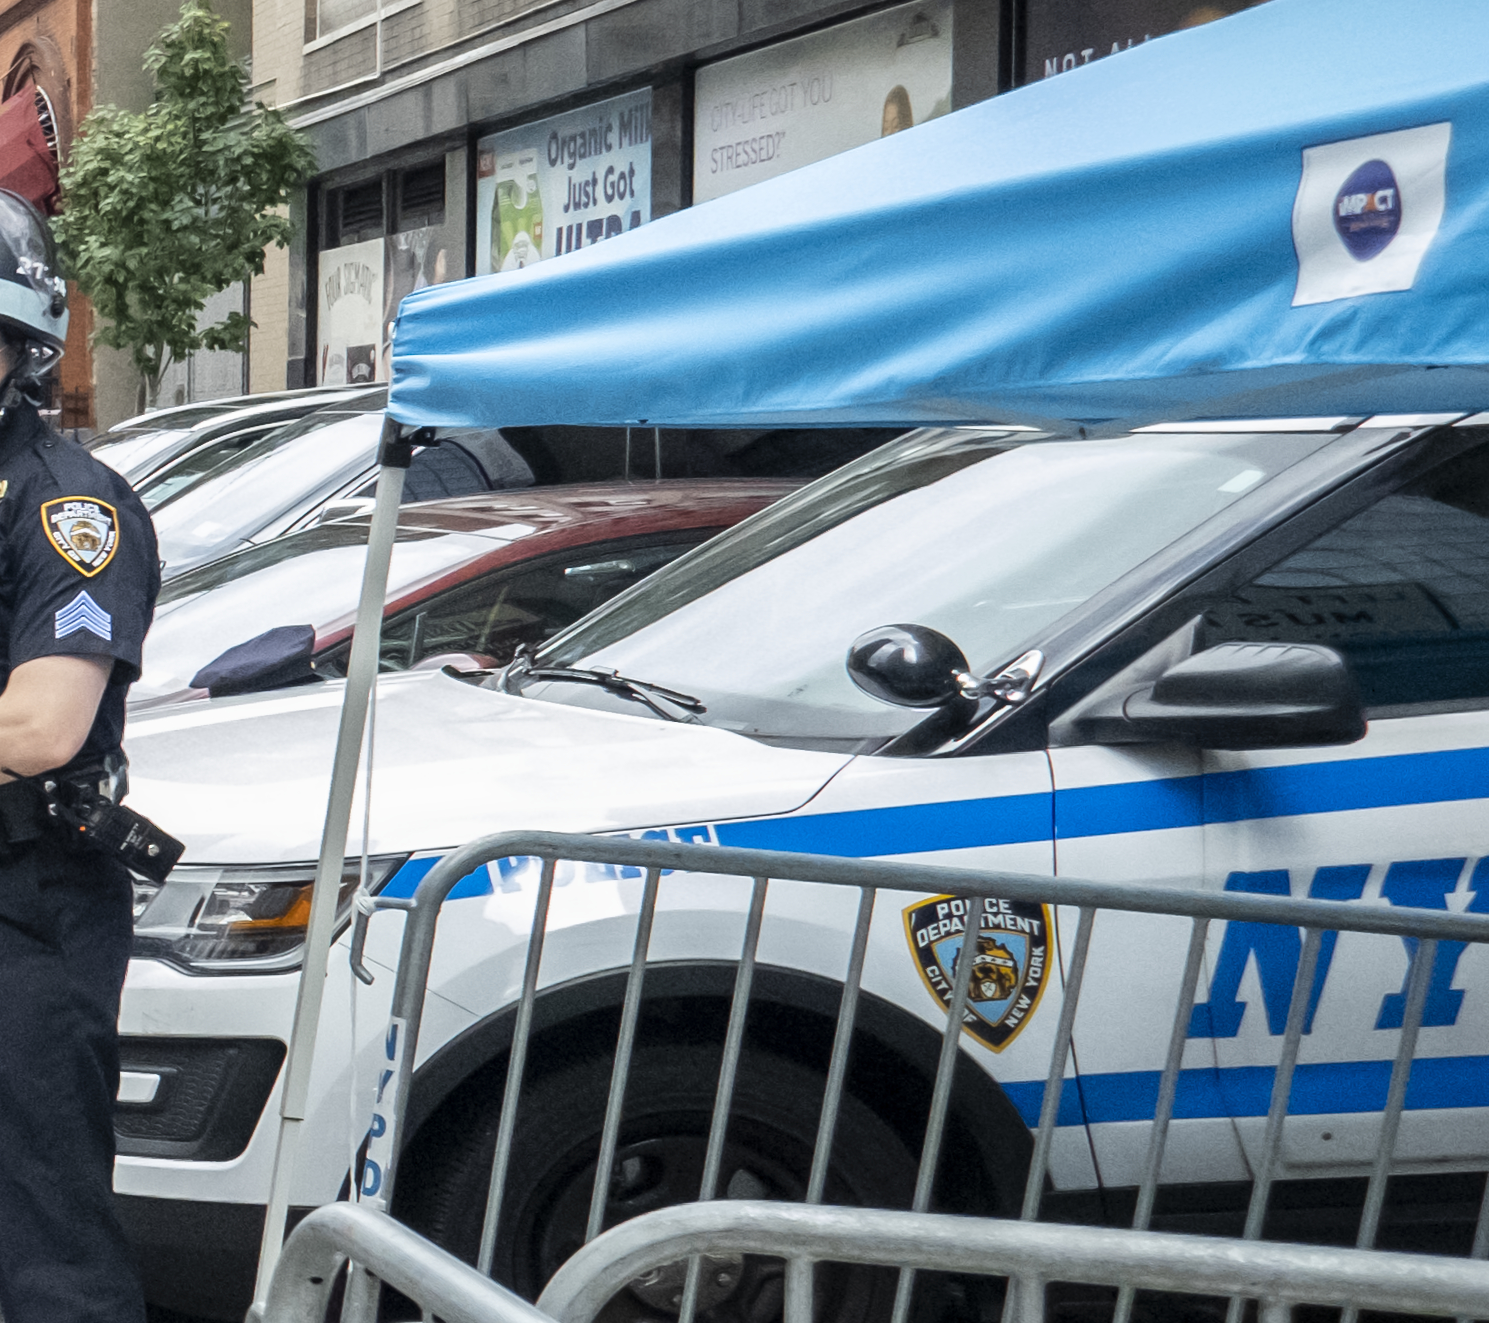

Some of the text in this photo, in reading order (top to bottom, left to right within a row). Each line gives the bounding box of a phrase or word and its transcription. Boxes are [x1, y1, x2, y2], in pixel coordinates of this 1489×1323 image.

[800, 75, 833, 108] YOU
[547, 117, 613, 171] Organic
[563, 161, 636, 214] Just Got
[936, 897, 1013, 920] POCE
[1004, 945, 1045, 1028] NEW YORK
